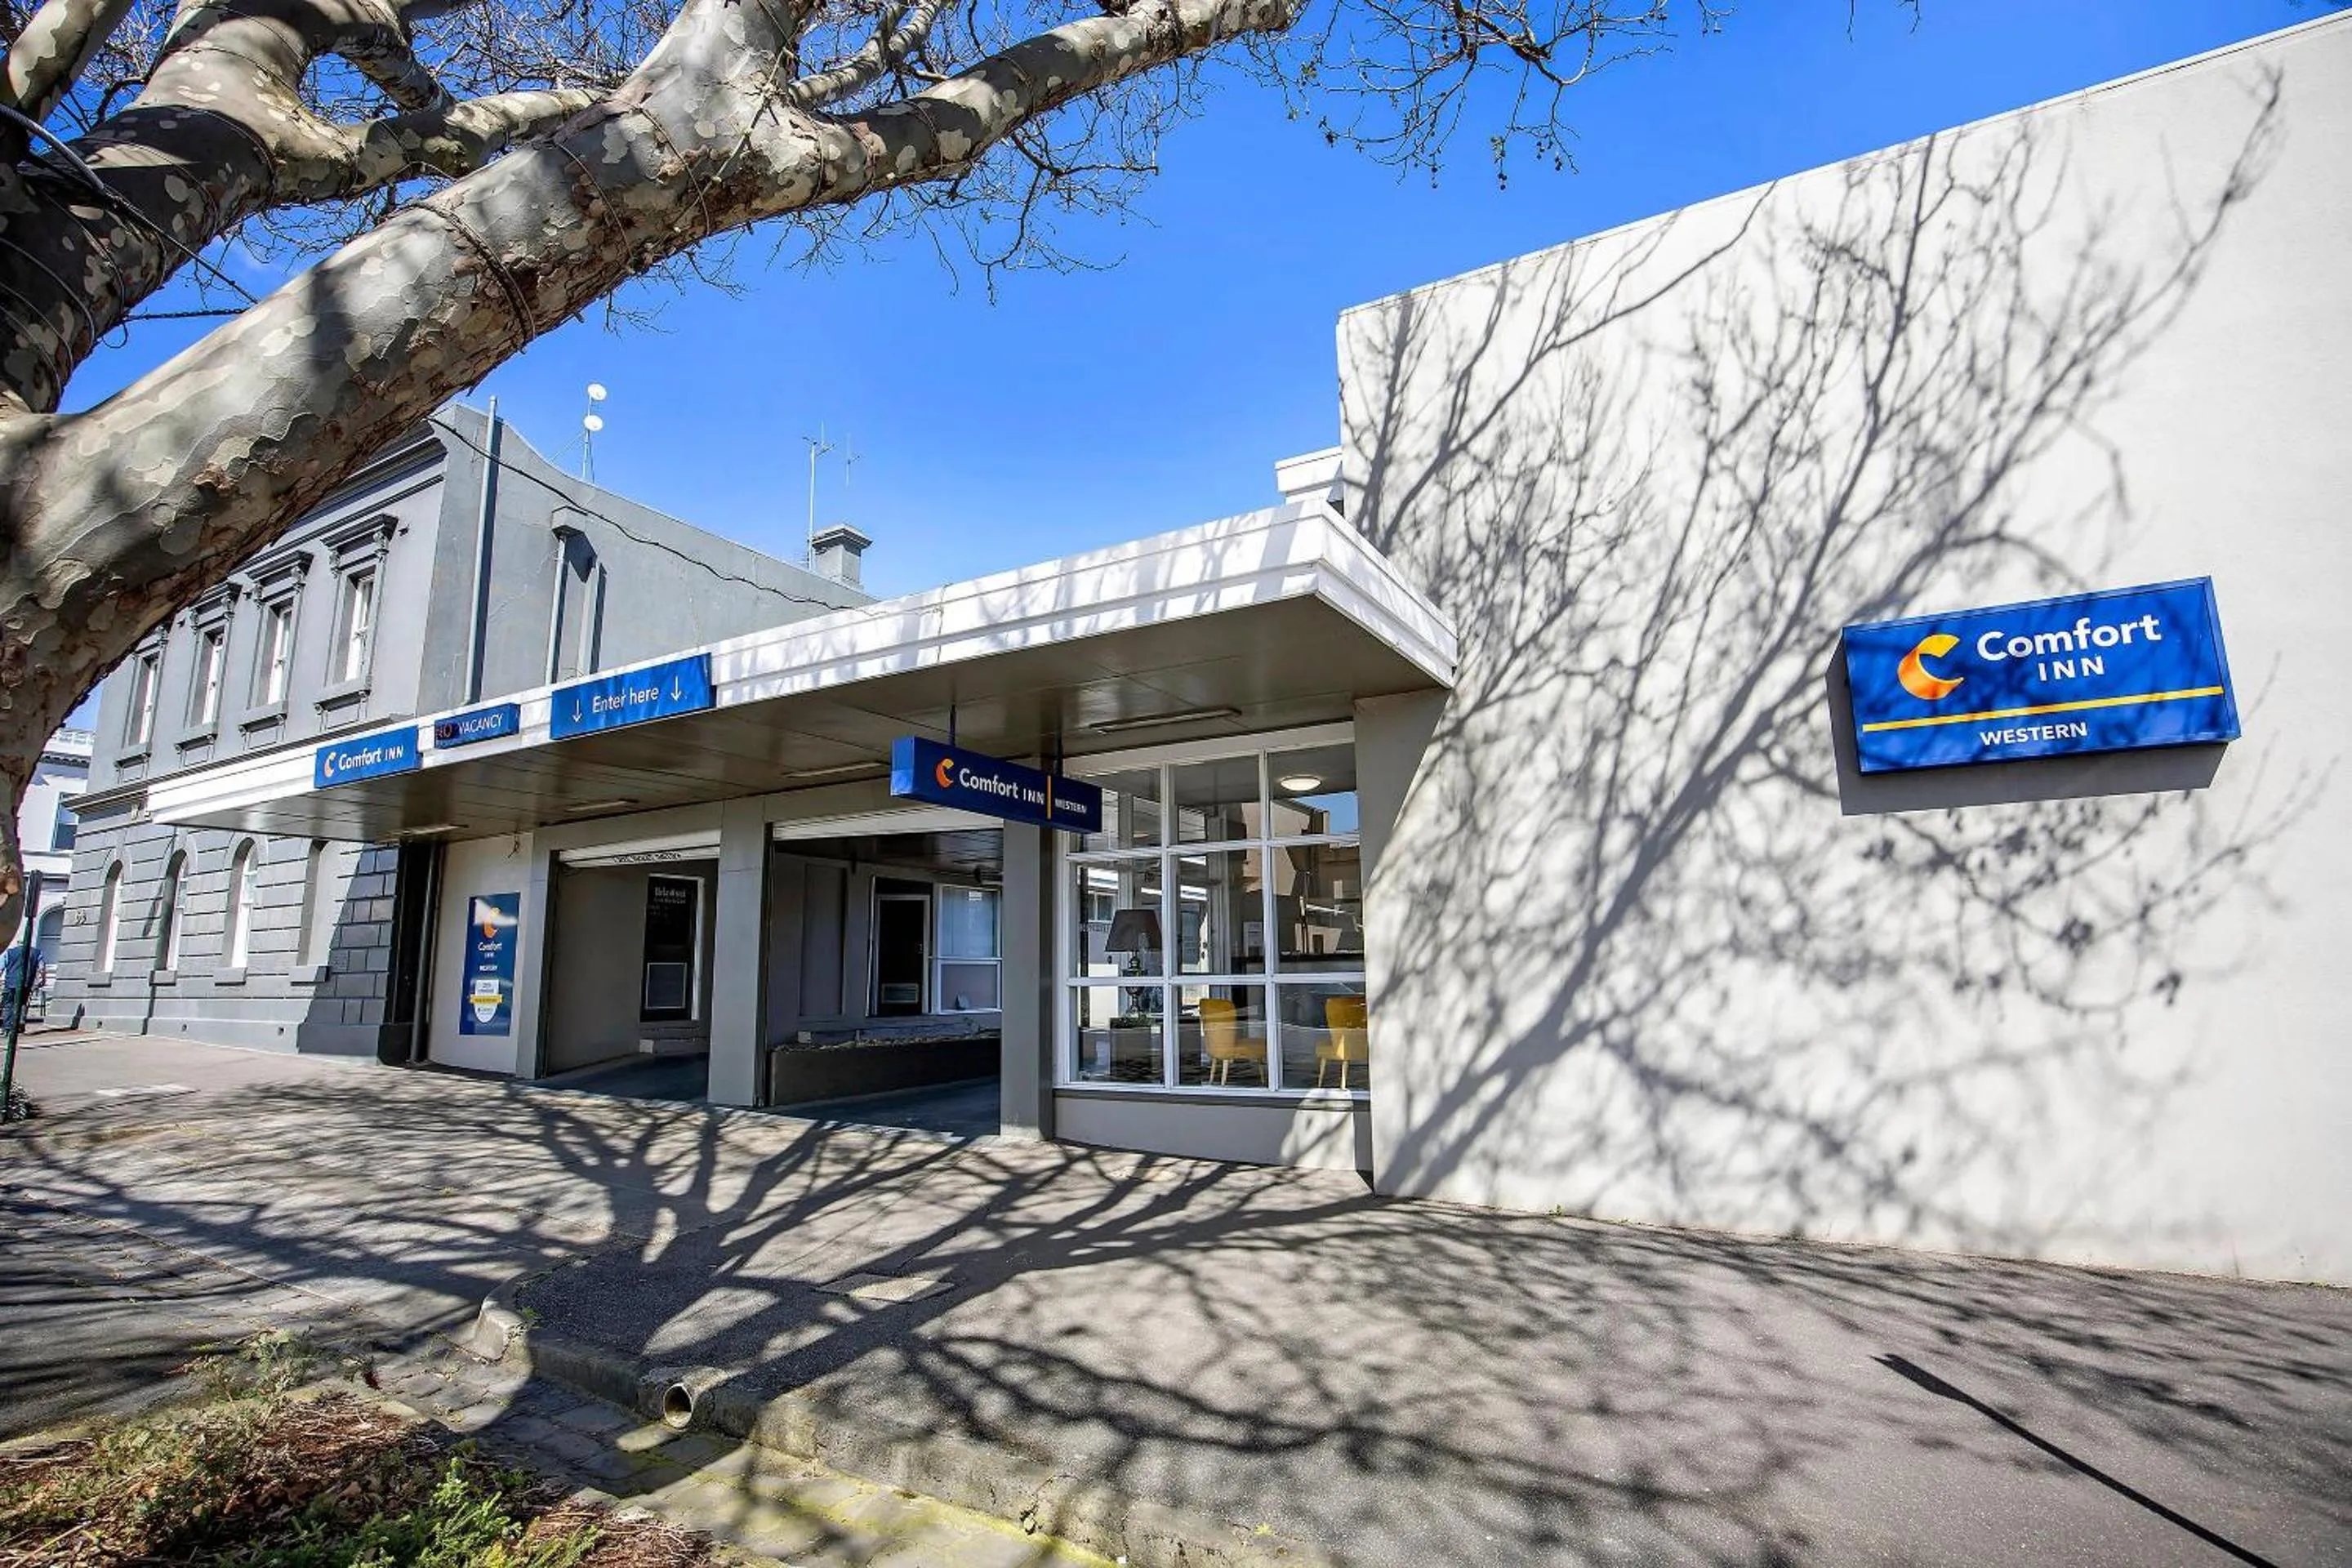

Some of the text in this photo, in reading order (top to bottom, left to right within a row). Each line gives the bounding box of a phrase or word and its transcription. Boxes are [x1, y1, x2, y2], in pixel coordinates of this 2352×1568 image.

[1976, 614, 2162, 662] Comfort
[2038, 655, 2105, 681] INN
[592, 687, 659, 714] Enter here
[458, 713, 504, 735] VACANCY
[1980, 722, 2088, 746] WESTERN
[338, 745, 404, 771] Comfort INN
[959, 768, 1019, 799] Comfort
[1022, 788, 1045, 804] INN
